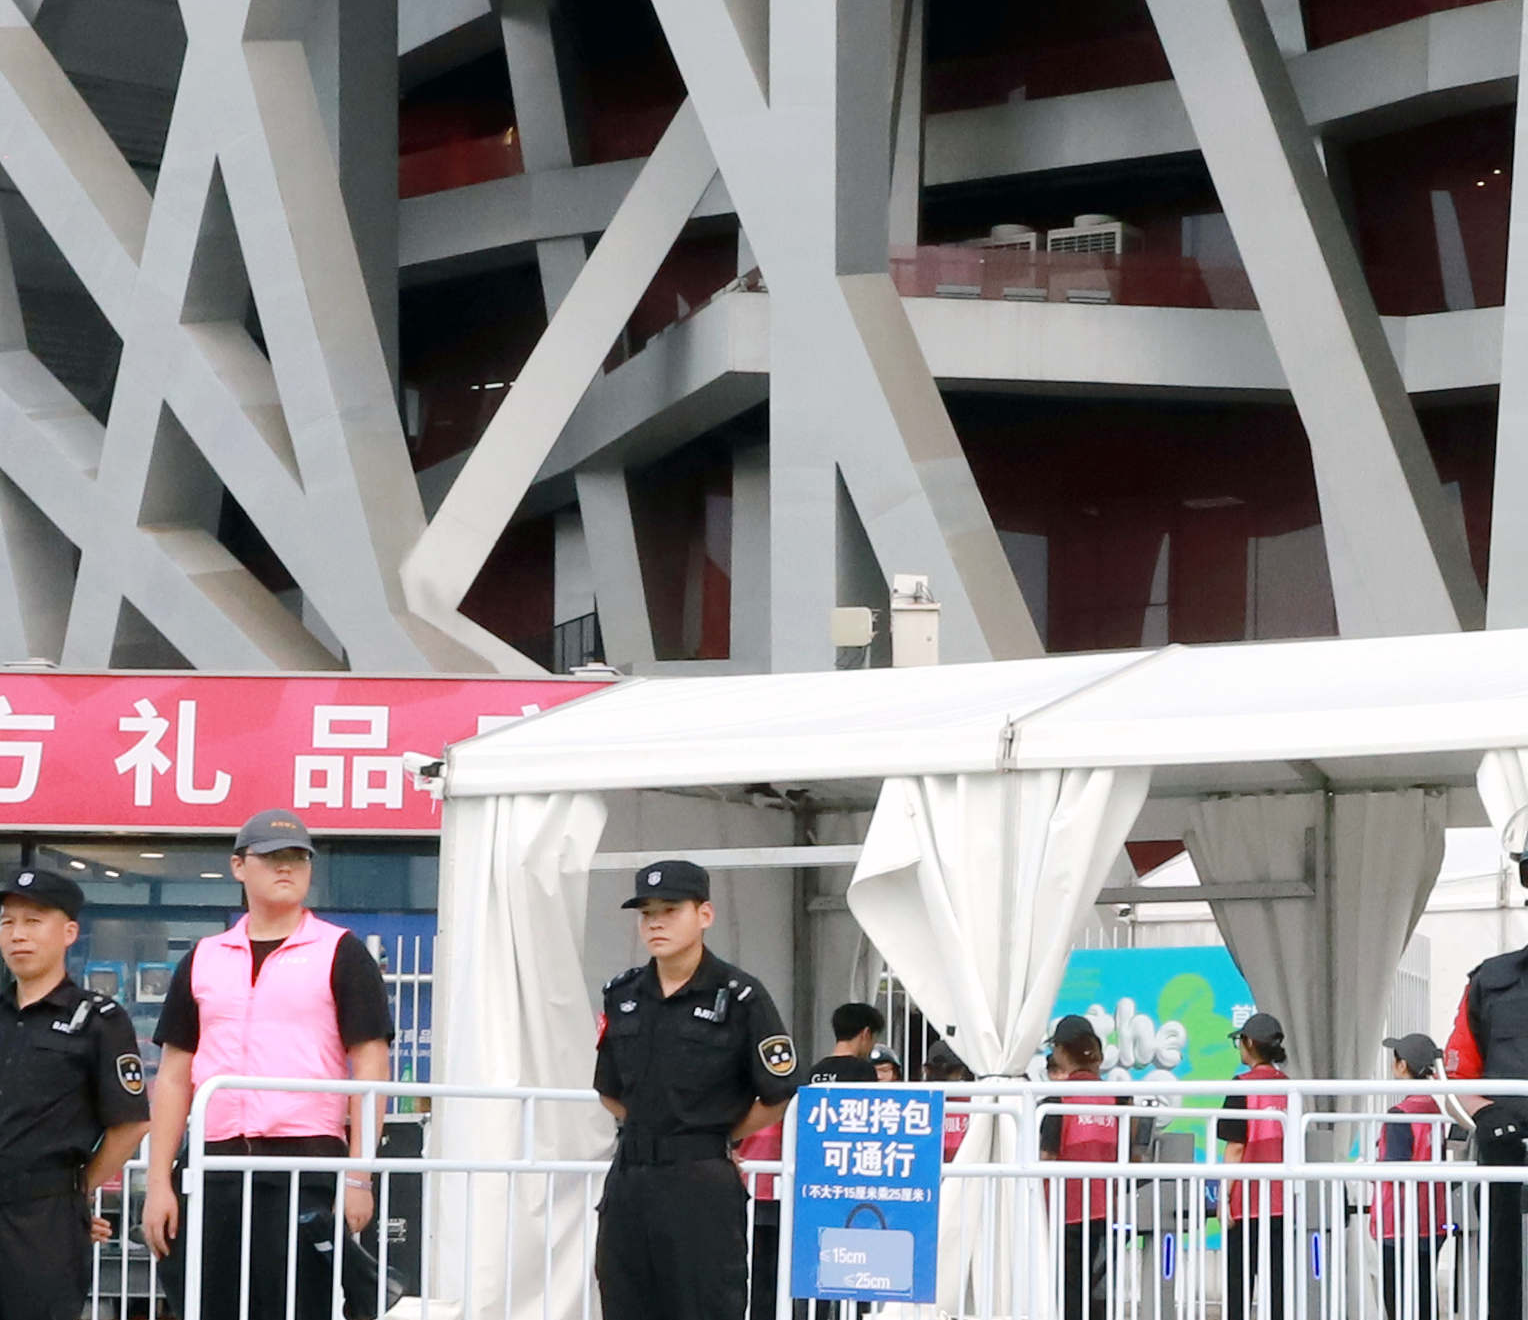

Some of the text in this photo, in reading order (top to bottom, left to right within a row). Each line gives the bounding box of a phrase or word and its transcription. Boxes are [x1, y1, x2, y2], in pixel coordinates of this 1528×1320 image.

[808, 1097, 932, 1135] 小型挎包
[823, 1141, 915, 1178] 可通行
